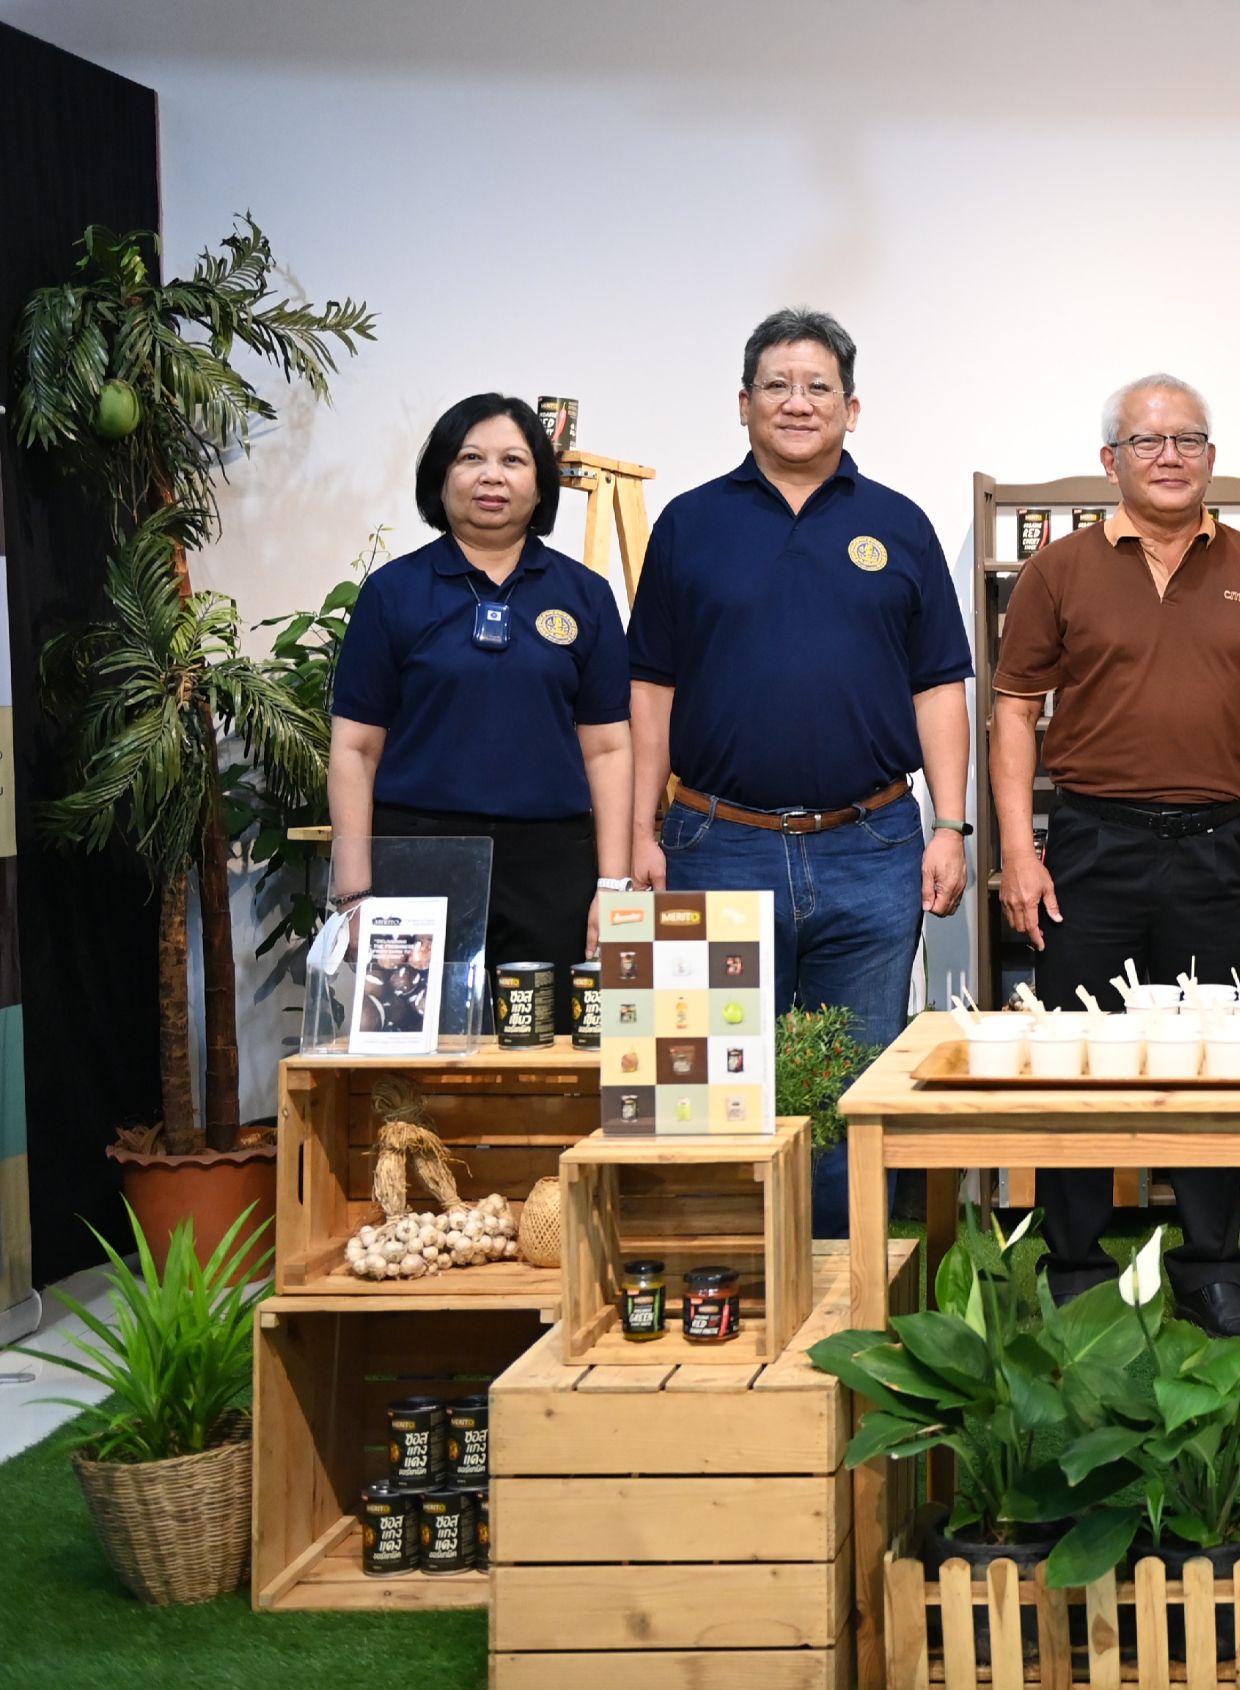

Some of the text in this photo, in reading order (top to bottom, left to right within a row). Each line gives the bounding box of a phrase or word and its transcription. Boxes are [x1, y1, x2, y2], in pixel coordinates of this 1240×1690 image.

[1023, 528, 1041, 538] RED
[661, 911, 700, 922] MERITO
[510, 990, 533, 1003] ซอส
[629, 1312, 654, 1322] GREEN
[405, 1432, 429, 1445] ซอส
[464, 1429, 488, 1442] ซอส
[380, 1515, 404, 1529] ซอส
[436, 1514, 459, 1528] ซอส
